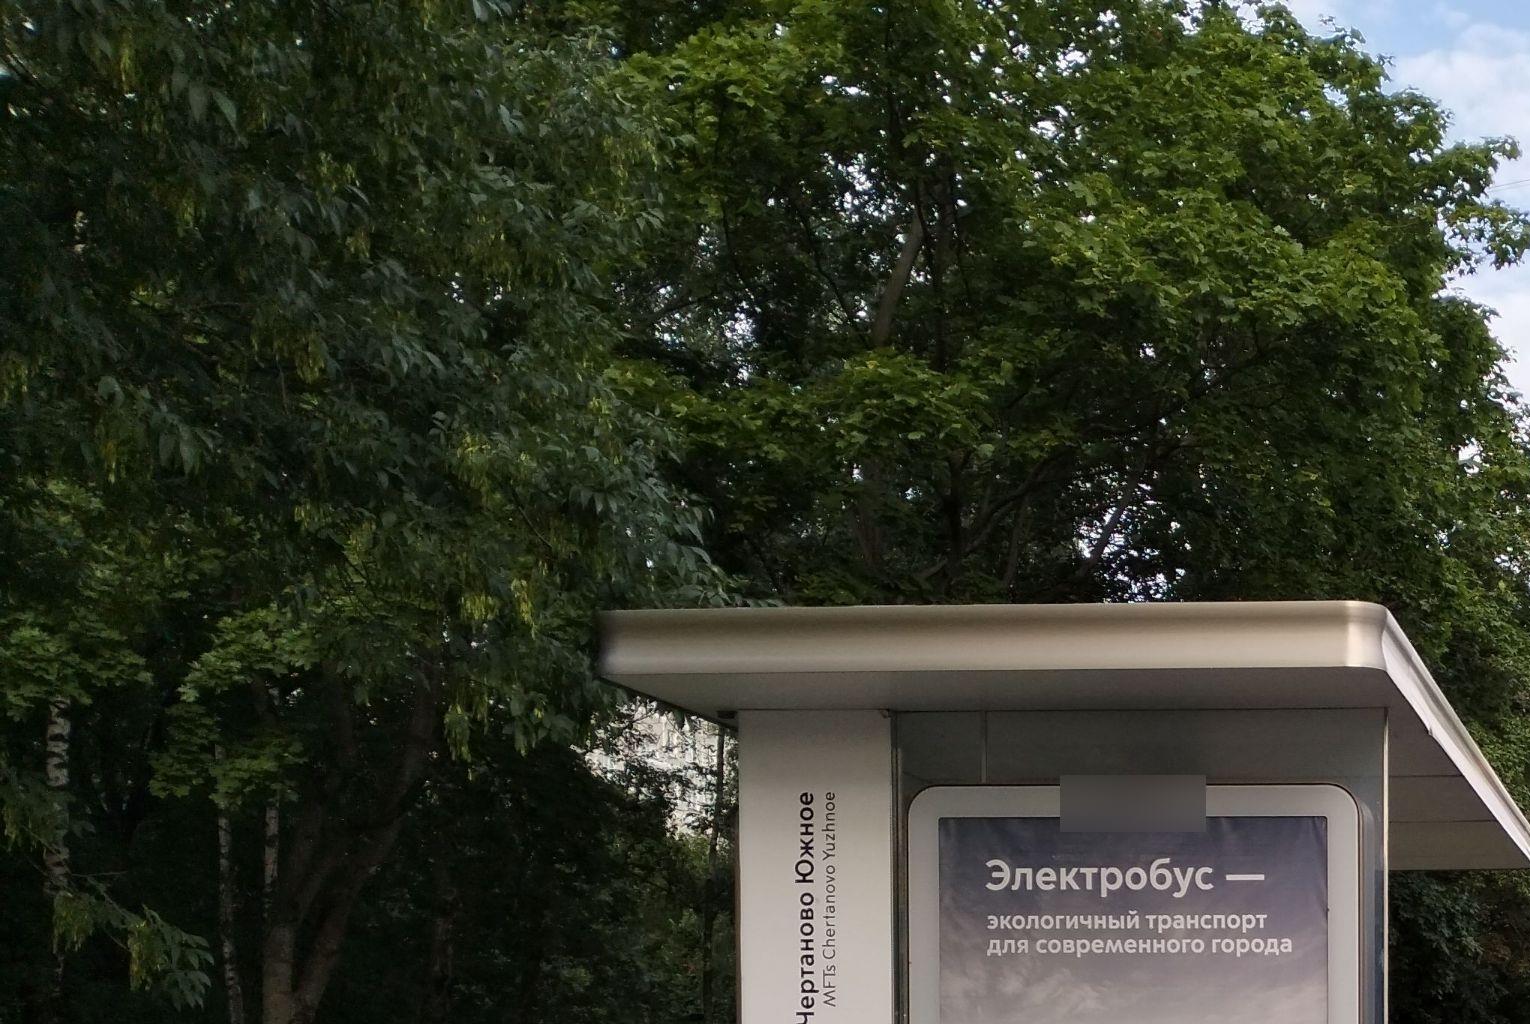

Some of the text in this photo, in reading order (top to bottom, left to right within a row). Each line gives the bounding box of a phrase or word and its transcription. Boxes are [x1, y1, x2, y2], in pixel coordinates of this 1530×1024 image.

[795, 792, 814, 883] Южное
[985, 858, 1214, 897] Электробус
[822, 792, 836, 1007] MFTs Chertanovo Yuzhnoe
[986, 910, 1267, 933] экологичный транспорт
[986, 937, 1293, 957] для современного города
